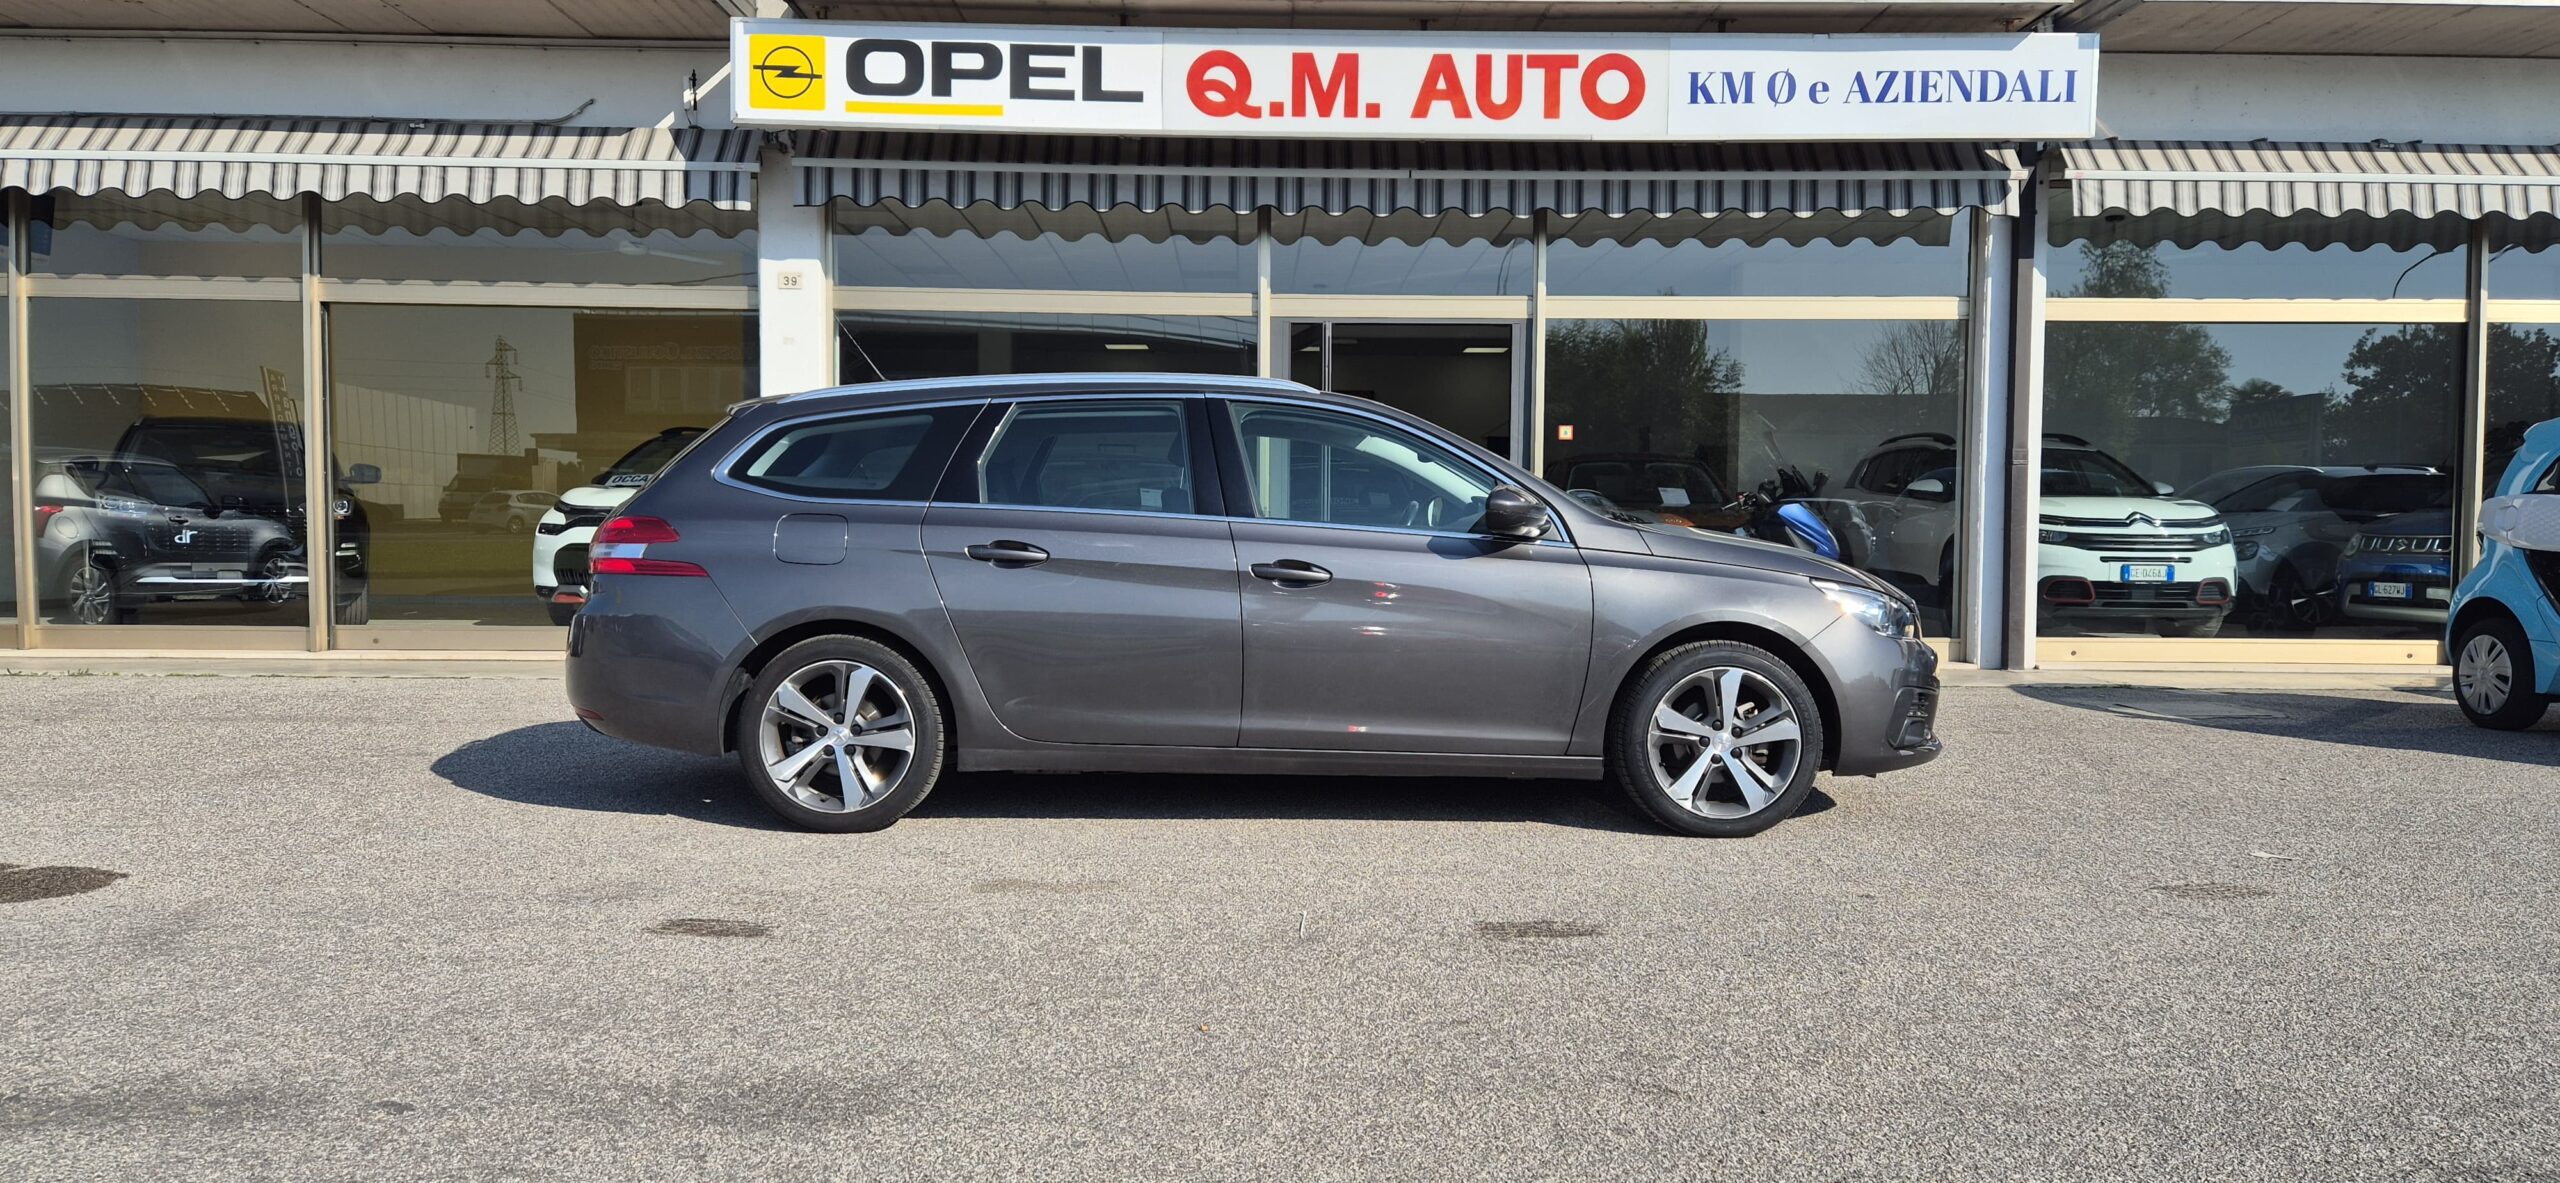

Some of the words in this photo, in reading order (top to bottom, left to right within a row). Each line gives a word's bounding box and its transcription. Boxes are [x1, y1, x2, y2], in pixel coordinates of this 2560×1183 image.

[846, 38, 1144, 103] OPEL
[1186, 49, 1381, 119] Q.M.
[1411, 53, 1646, 121] AUTO
[1687, 71, 1754, 105] KM
[1808, 83, 1830, 105] e
[1843, 70, 2077, 105] AZIENDALI
[783, 276, 798, 287] 39
[174, 529, 199, 544] dr
